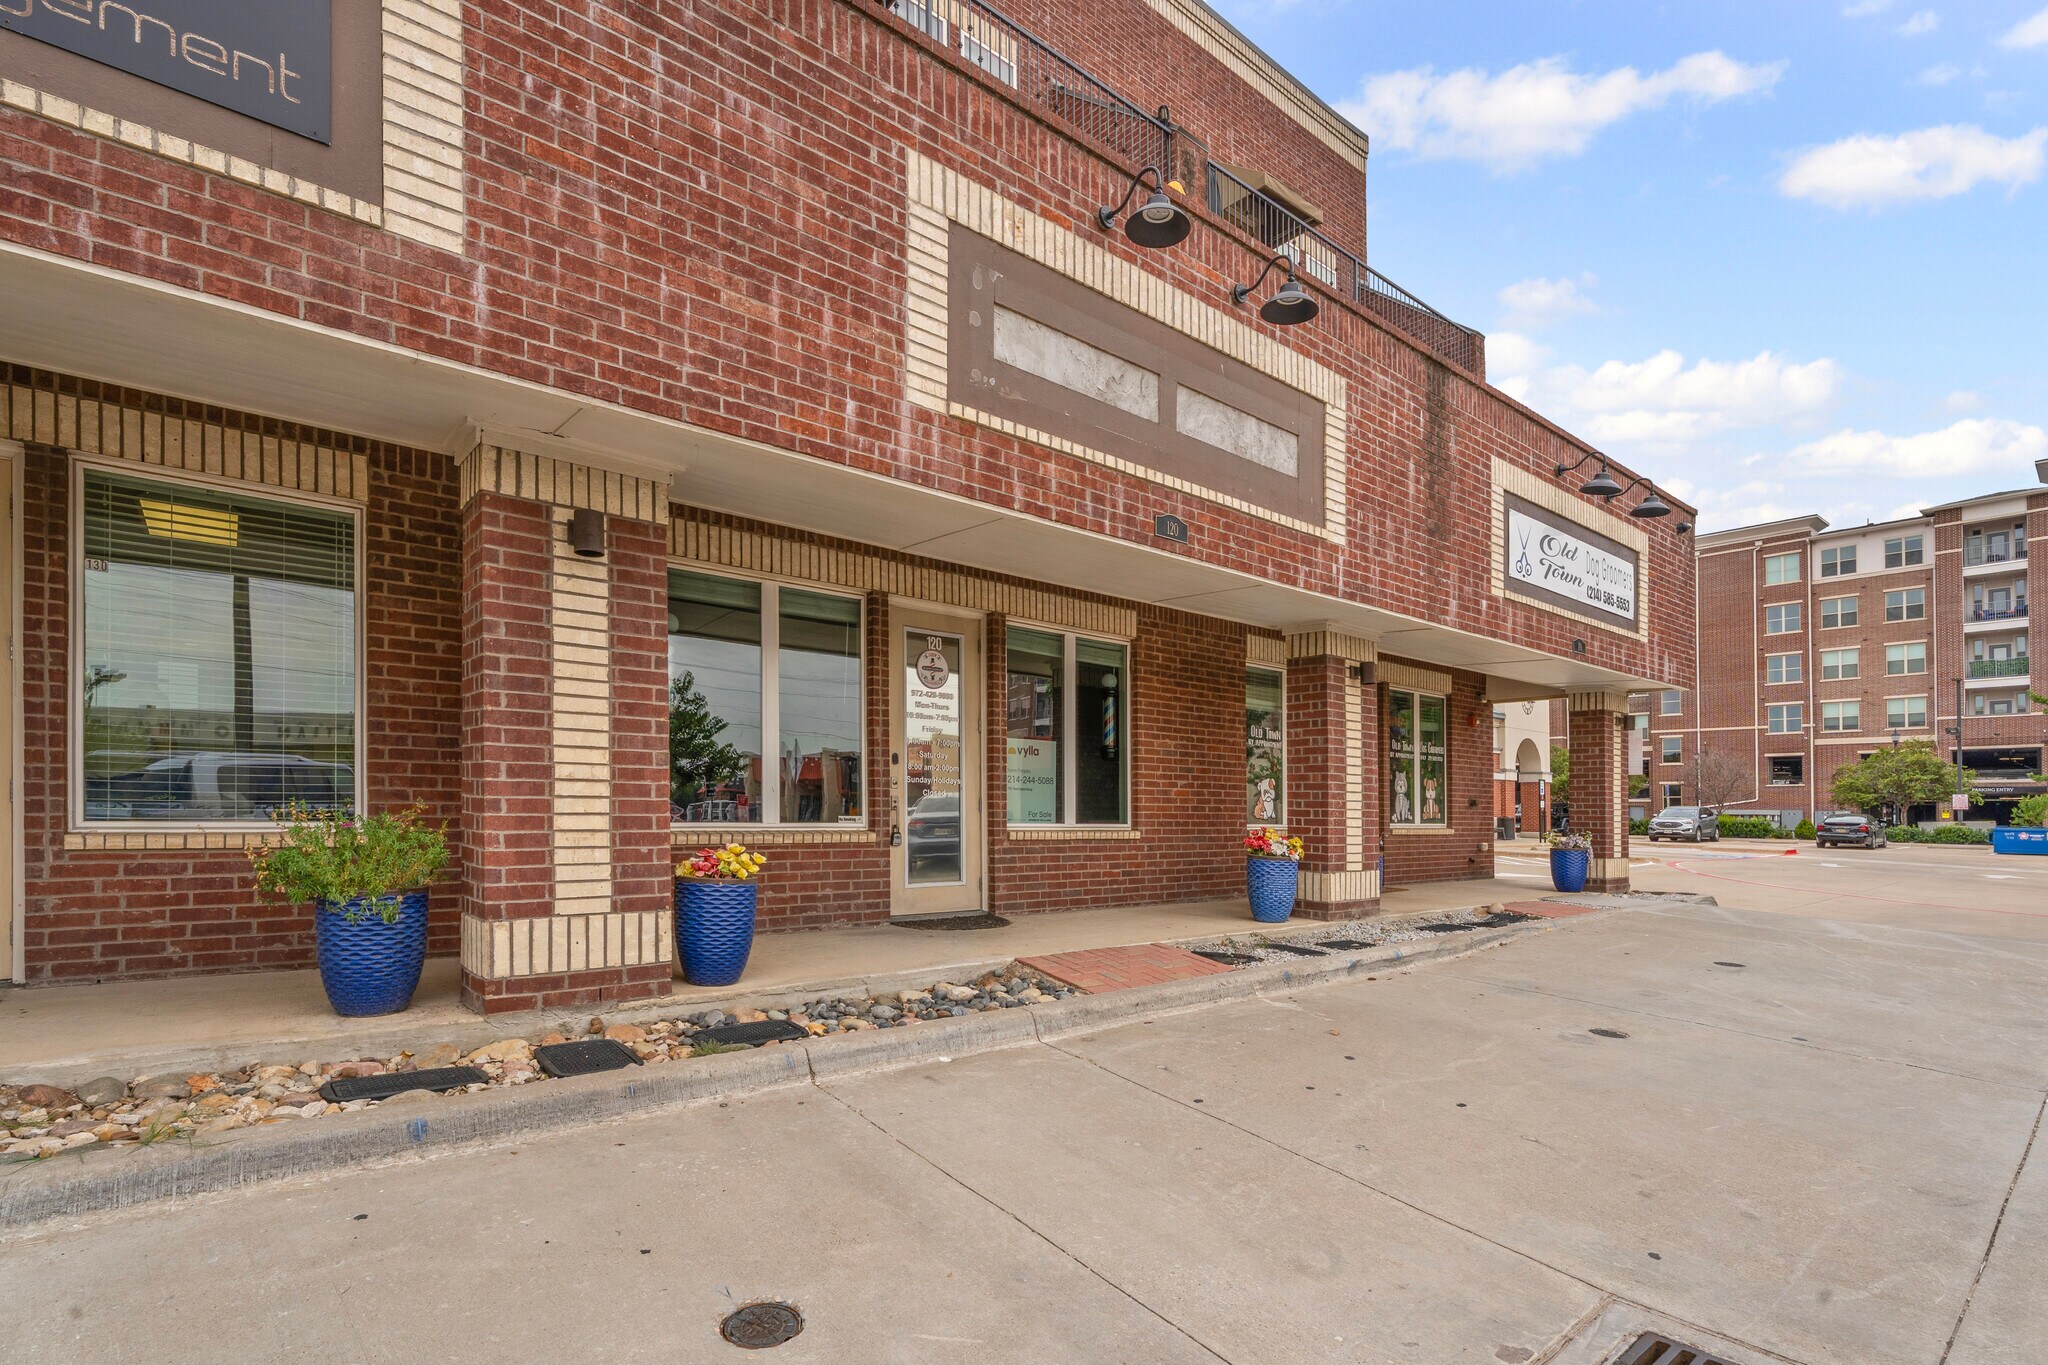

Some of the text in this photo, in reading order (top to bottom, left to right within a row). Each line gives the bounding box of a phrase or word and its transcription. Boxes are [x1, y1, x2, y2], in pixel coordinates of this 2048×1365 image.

[1167, 521, 1179, 537] 120
[1540, 534, 1578, 561] Old
[86, 559, 108, 571] 130
[1586, 550, 1632, 591] Dog Groomers
[1539, 558, 1584, 588] Town
[1586, 584, 1602, 602] (214)
[926, 636, 942, 650] 120
[914, 701, 950, 711] Mon-Thurs
[921, 725, 943, 735] Friday
[1250, 725, 1263, 738] OLD
[918, 750, 949, 760] Saturday
[1017, 745, 1040, 758] vylla
[1007, 775, 1055, 785] 214-244-5088
[922, 788, 946, 797] Closed
[1028, 810, 1038, 818] For
